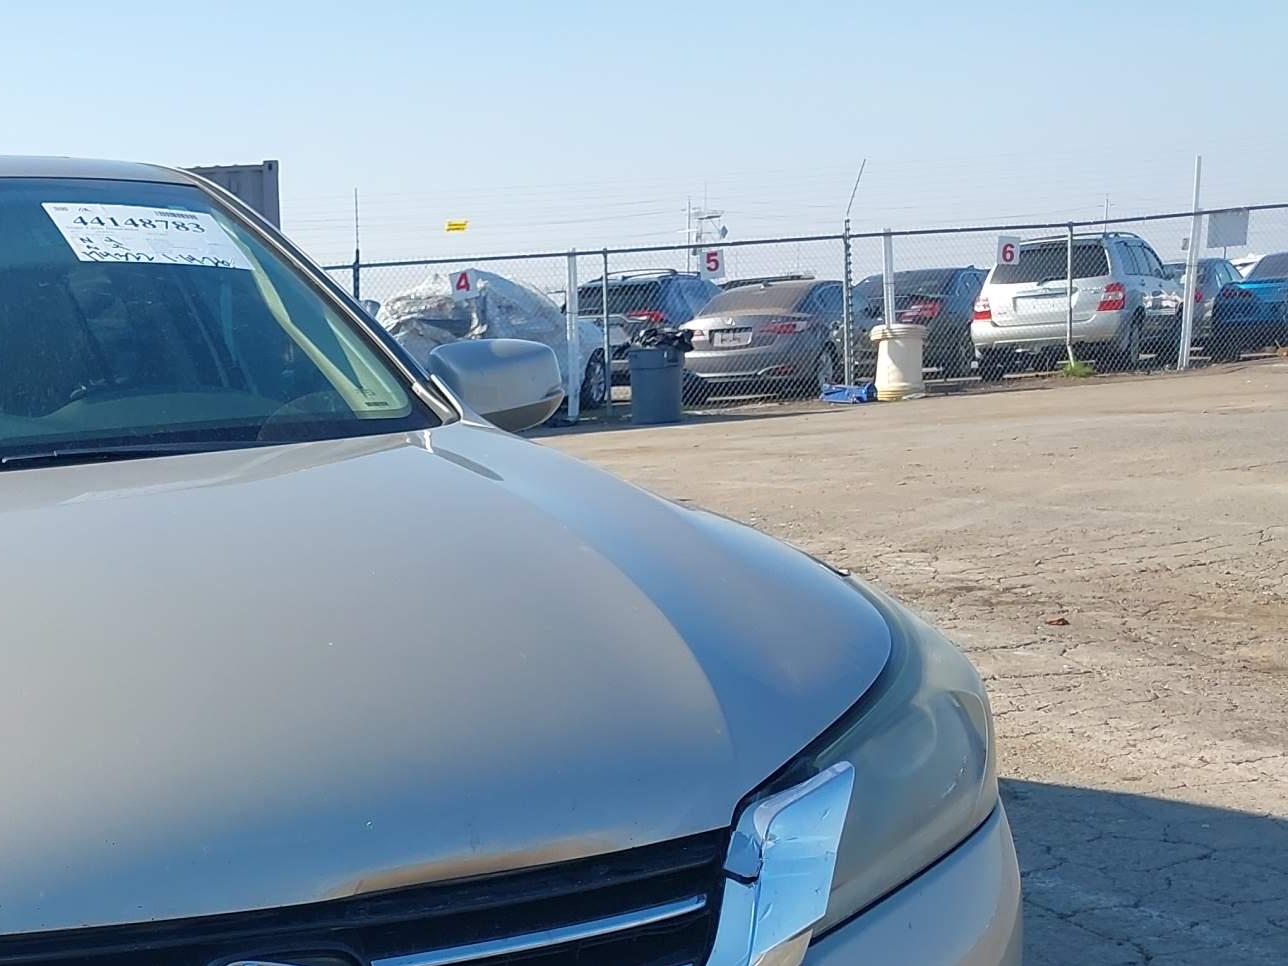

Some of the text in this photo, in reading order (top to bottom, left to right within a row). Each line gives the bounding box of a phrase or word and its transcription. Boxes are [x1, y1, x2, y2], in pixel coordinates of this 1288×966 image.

[72, 215, 206, 234] 44148783
[706, 251, 720, 272] 5
[1001, 243, 1015, 262] 6
[456, 271, 471, 292] 4
